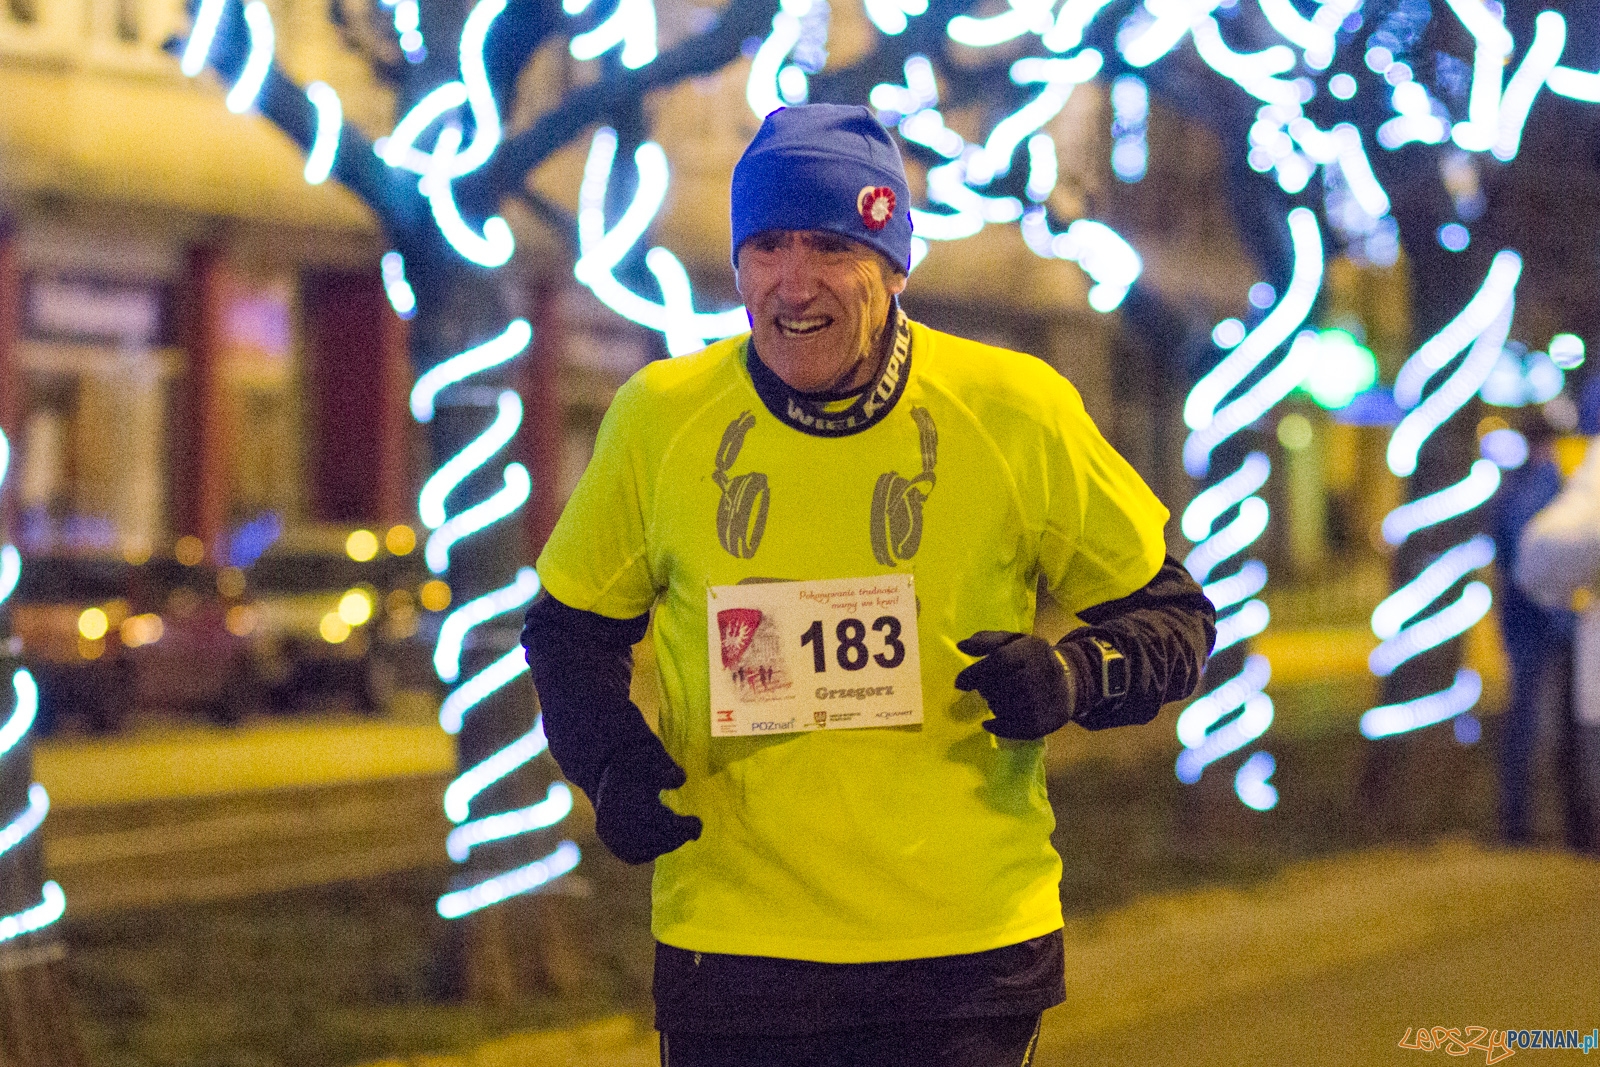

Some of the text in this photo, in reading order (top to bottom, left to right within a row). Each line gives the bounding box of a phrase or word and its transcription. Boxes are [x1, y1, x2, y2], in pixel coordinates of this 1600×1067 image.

[799, 589, 855, 605] Pokonywanie
[831, 602, 858, 614] mamy
[801, 615, 906, 674] 183
[814, 685, 895, 700] Grzegorz
